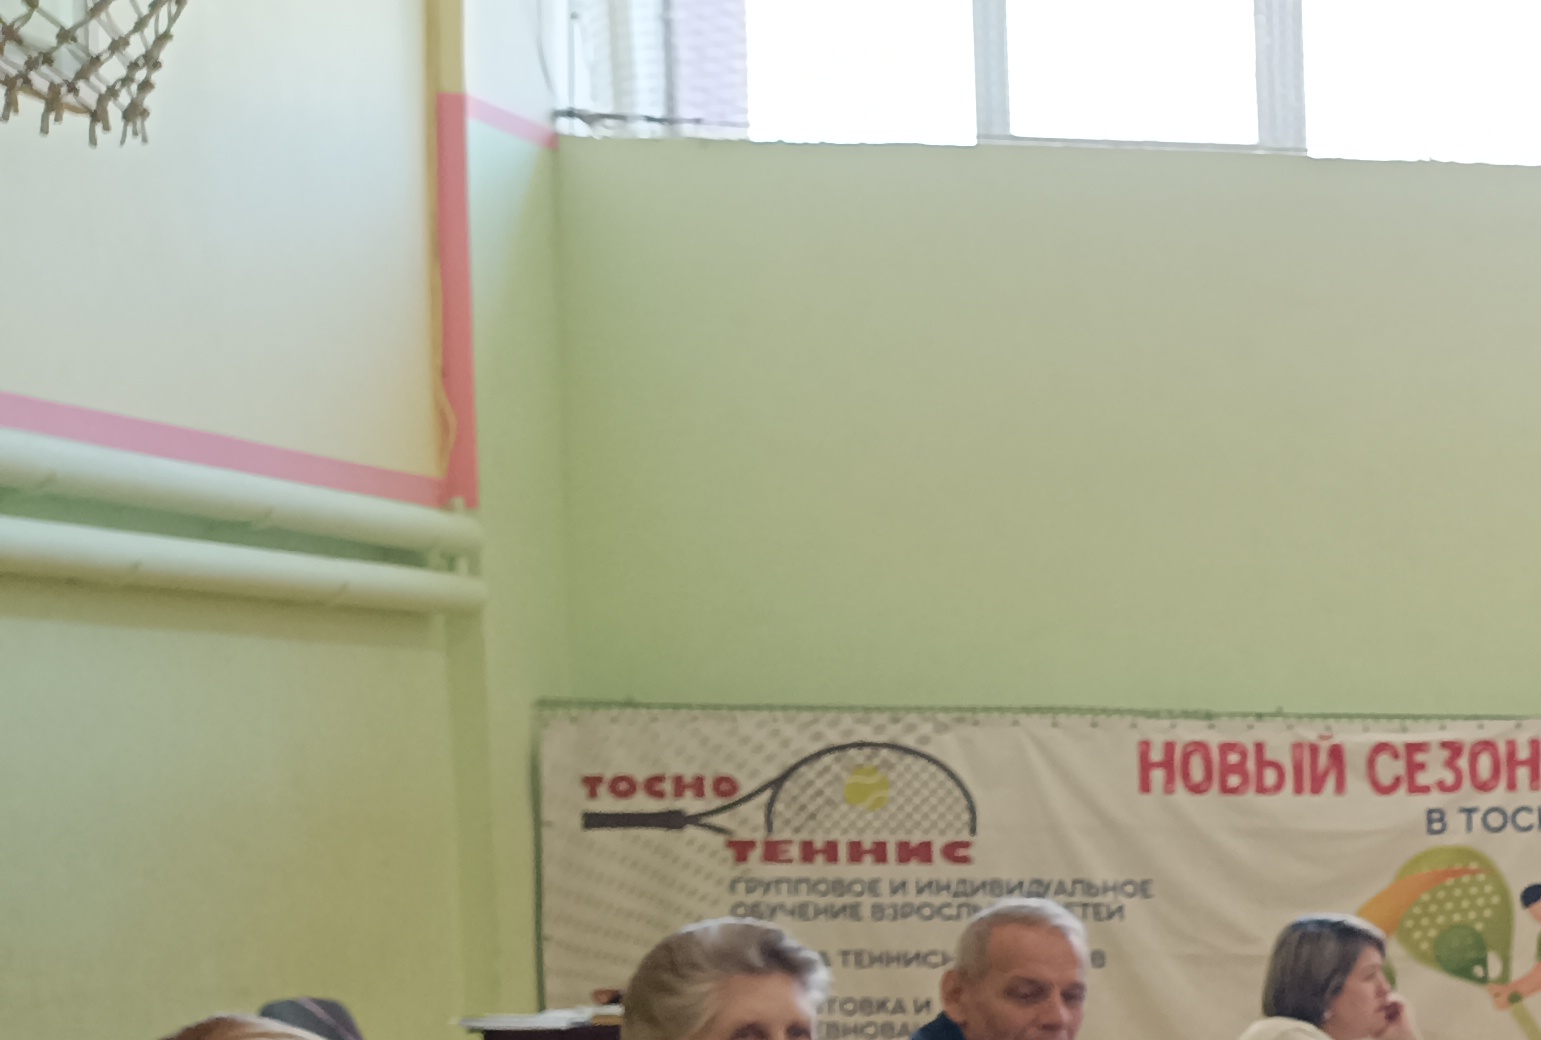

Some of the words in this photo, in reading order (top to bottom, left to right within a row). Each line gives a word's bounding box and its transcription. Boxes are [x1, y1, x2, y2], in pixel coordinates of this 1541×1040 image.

[1137, 733, 1347, 796] НОВЫЙ
[1366, 738, 1541, 796] СЕЗОН
[581, 774, 739, 799] ТОСНО
[1426, 806, 1448, 835] В
[726, 839, 974, 865] ТЕННИС
[729, 876, 882, 898] ГРУППОВОЕ
[889, 877, 907, 897] И
[915, 877, 1154, 899] ИНДИВИДУАЛЬНОЕ
[730, 901, 863, 921] ОБУЧЕНИЕ
[871, 901, 978, 922] ВЗРОСЛ
